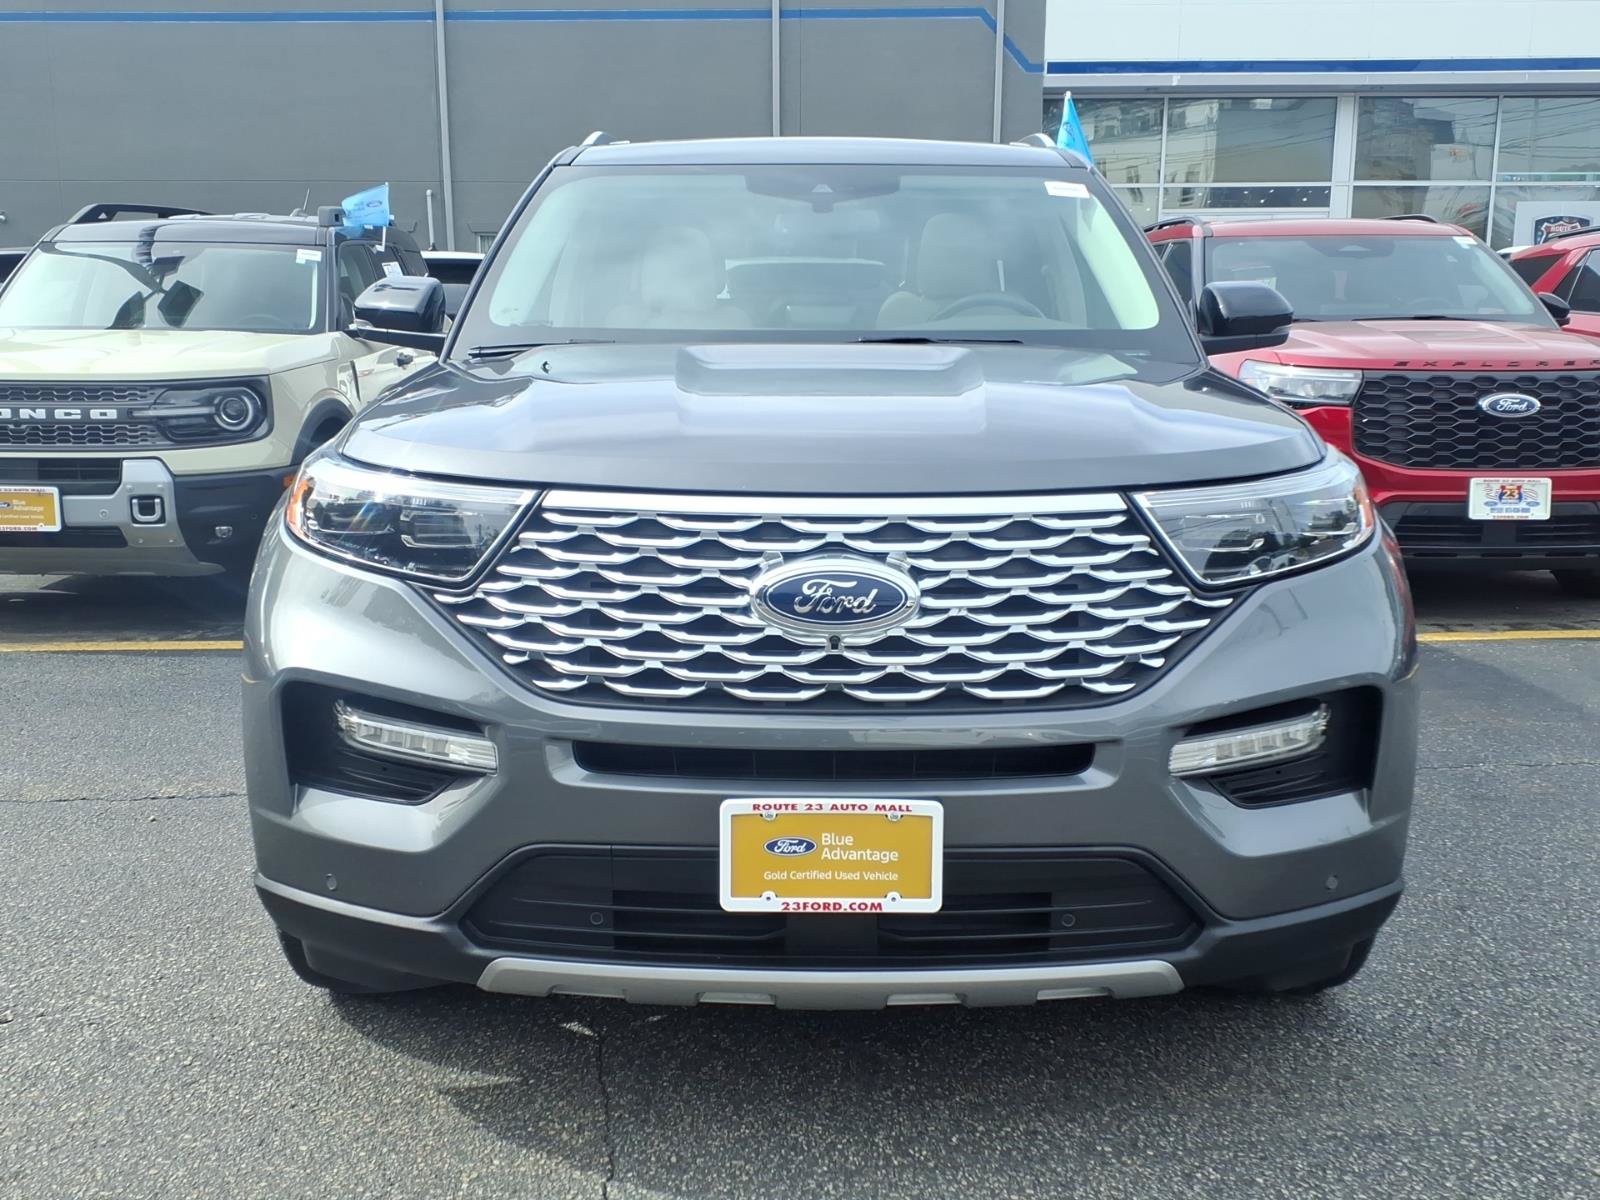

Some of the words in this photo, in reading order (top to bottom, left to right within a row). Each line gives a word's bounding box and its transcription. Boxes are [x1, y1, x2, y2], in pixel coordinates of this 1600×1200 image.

[1496, 398, 1528, 412] Ford
[793, 578, 879, 614] Ford
[752, 803, 799, 812] ROUTE
[805, 803, 824, 812] 23
[830, 803, 868, 812] AUTO
[874, 803, 913, 812] MALL
[821, 832, 854, 846] Blue
[773, 839, 807, 854] Ford
[821, 847, 899, 864] Advantage
[763, 870, 788, 881] Gold
[789, 870, 832, 881] Certified
[834, 871, 860, 881] Used
[863, 871, 899, 881] Vehicle
[781, 901, 883, 912] 23FORD.COM
